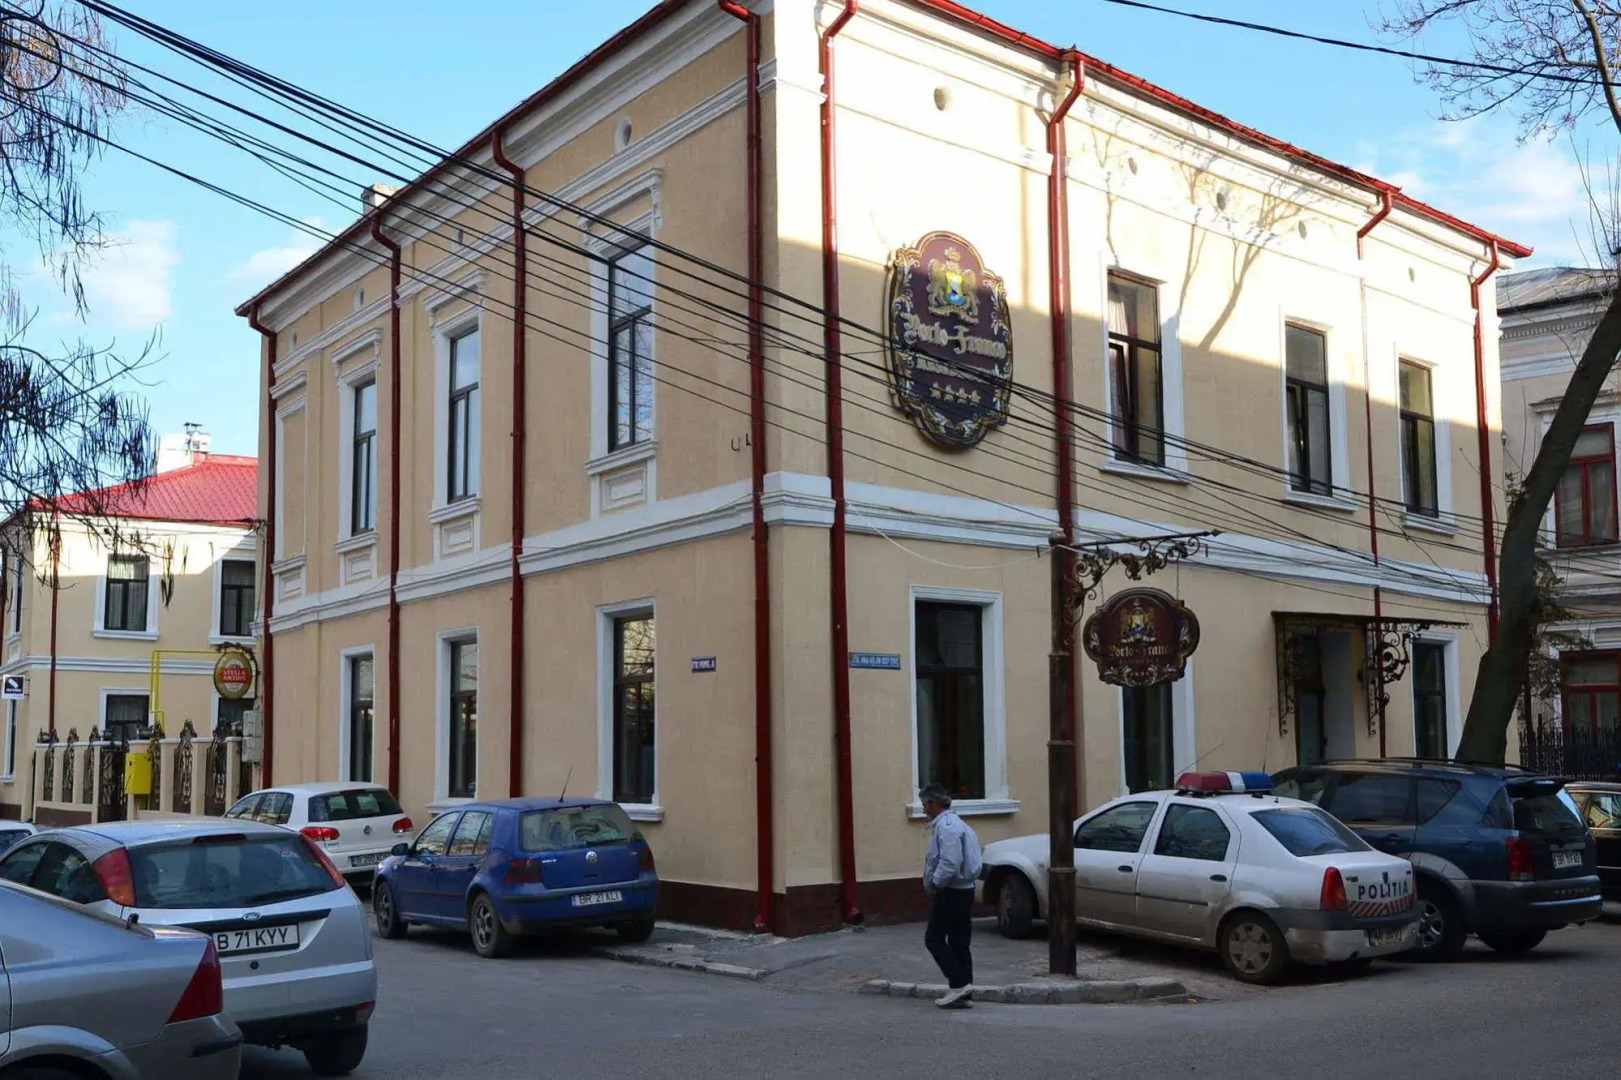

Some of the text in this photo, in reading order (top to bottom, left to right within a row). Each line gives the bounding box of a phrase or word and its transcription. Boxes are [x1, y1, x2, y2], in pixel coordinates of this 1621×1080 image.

[217, 927, 288, 950] B 71 KYY
